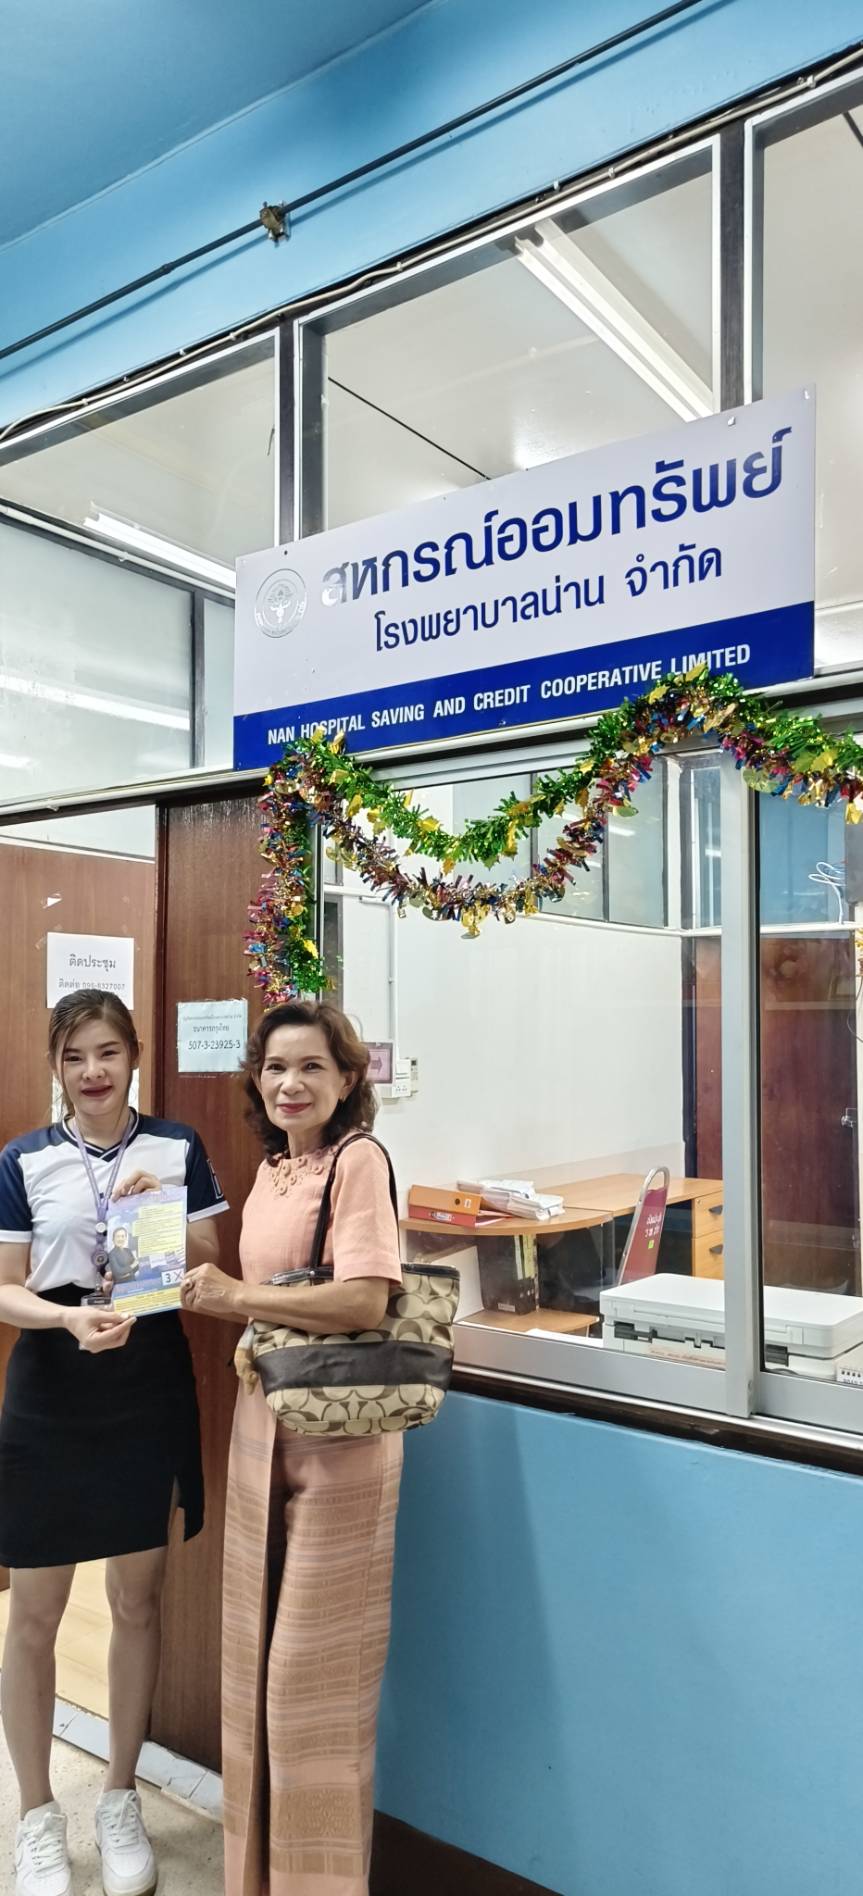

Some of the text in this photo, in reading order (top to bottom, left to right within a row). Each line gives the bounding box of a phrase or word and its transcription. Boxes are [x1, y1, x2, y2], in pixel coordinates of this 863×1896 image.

[321, 426, 793, 607] สหกรณ์ออมทรัพย์
[374, 574, 605, 652] โรงพยาบาลน่าน
[625, 542, 723, 597] จำกัด
[268, 643, 751, 745] NAN HOSPITAL SAVING AND CREDIT COOPERATIVE LIMITED
[69, 953, 116, 972] ติดประชุม
